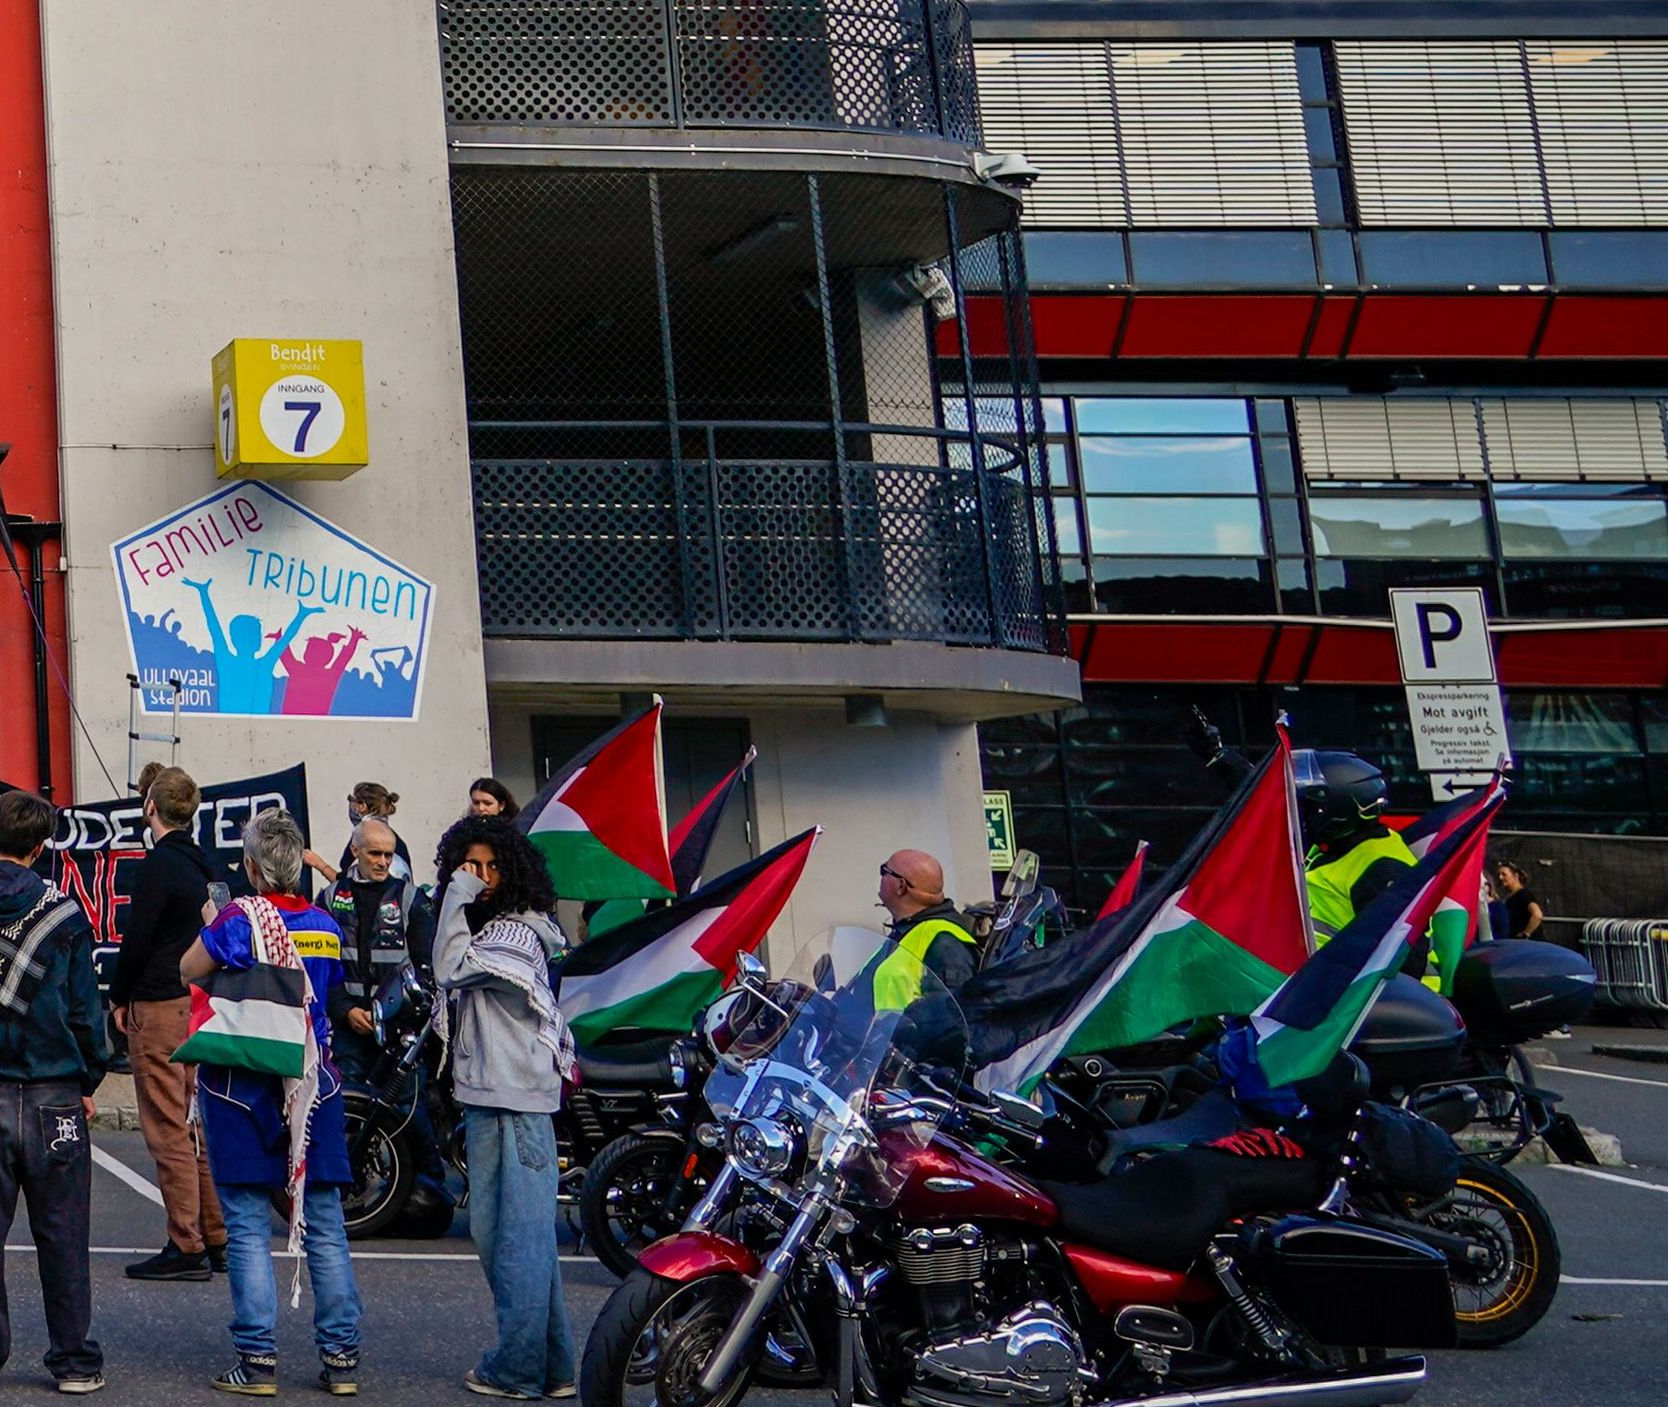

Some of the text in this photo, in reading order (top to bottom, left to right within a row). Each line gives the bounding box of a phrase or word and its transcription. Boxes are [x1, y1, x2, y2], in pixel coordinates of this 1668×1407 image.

[270, 342, 326, 362] Bendit
[277, 384, 325, 394] INNGANG
[284, 401, 321, 453] 7
[1416, 602, 1463, 669] P
[1422, 706, 1489, 720] Mot avgift
[1420, 724, 1480, 736] Gjelder også
